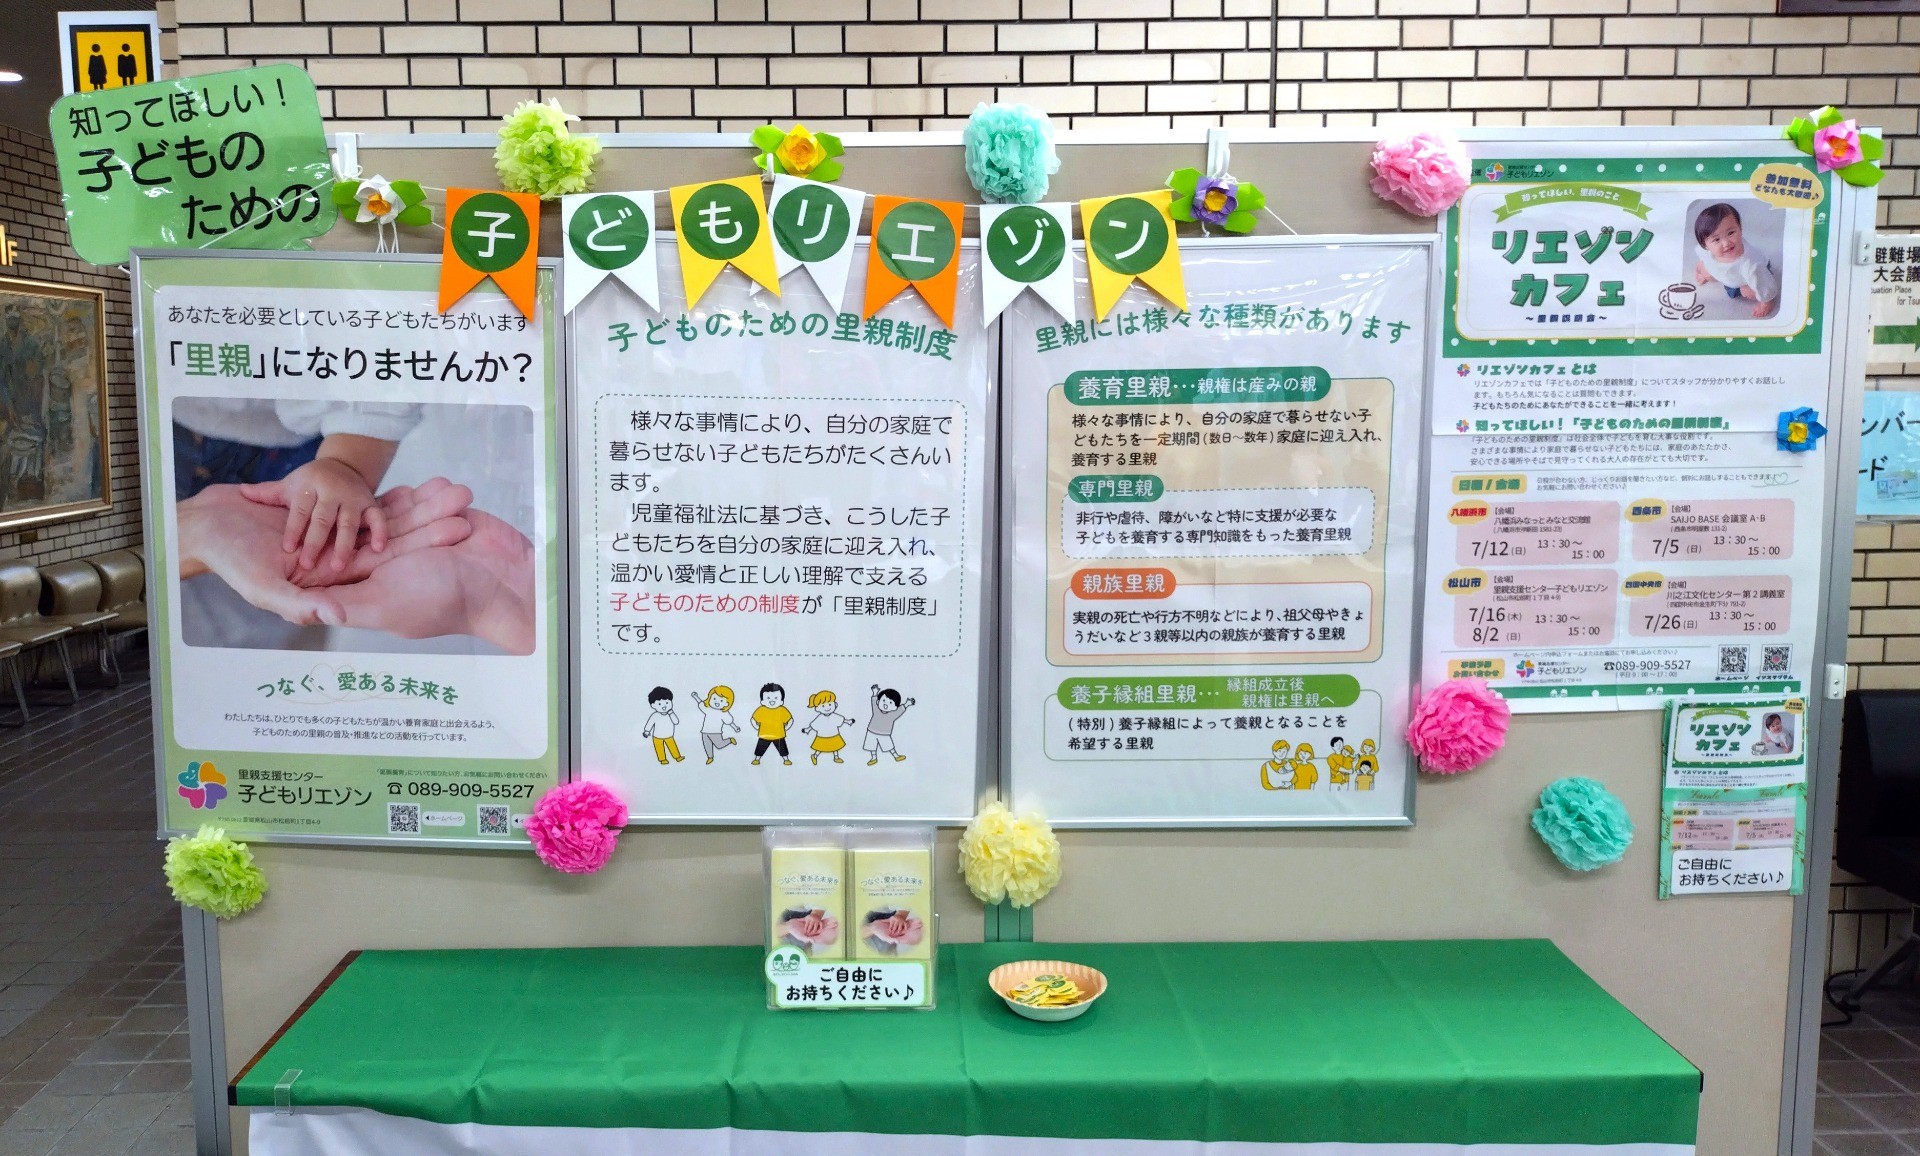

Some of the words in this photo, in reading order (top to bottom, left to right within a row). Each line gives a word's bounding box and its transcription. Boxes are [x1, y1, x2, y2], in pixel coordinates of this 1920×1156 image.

[69, 78, 287, 138] 知ってほしい！
[78, 130, 266, 194] 子どもの
[182, 183, 321, 241] ための
[1491, 225, 1655, 265] リエゾン
[1509, 272, 1626, 307] カフェ
[1894, 285, 1912, 294] Place
[1897, 296, 1906, 306] for
[168, 304, 527, 331] あなたを必要としている子どもたちがいます
[607, 310, 959, 362] 子どものための里親制度
[1035, 302, 1412, 354] 里親には様々な種類があります
[169, 340, 533, 383] 「里親」になりませんか？
[630, 410, 953, 436] 様々な事情により、自分の家庭で
[1071, 408, 1372, 428] 様々な事情により、自分の家庭で暮らせない子
[609, 441, 952, 466] 暮らせない子どもたちがたくさんい
[1071, 452, 1158, 467] 養育する里親
[609, 472, 661, 494] ます。
[1078, 479, 1153, 498] 専門里親
[631, 503, 951, 527] 児童福祉法に基づき、こうした子
[1076, 508, 1337, 526] 非行や虐待、障がいなど特に支援が必要な
[1671, 515, 1696, 524] SAIJO
[1698, 515, 1720, 523] BASE
[1722, 514, 1748, 523] 会議室
[611, 534, 937, 557] どもたちを自分の家庭に迎え入れ、
[1076, 527, 1352, 545] 子どもを養育する専門知識をもった養育里親
[1472, 541, 1509, 559] 7/12
[1511, 546, 1526, 555] (日)
[1652, 538, 1680, 558] 7/5
[1686, 545, 1702, 555] (日)
[610, 563, 928, 588] 温かい愛情と正しい理解で支える
[1082, 574, 1165, 594] 親族里親
[1448, 577, 1481, 588] 松山市
[609, 593, 938, 618] 子どものための制度が「里親制度」
[1072, 607, 1364, 625] 実親の死亡や行方不明などにより、祖父母やきょ
[1469, 607, 1506, 625] 7/16
[1507, 612, 1522, 622] (木)
[1645, 614, 1681, 633] 7/26
[1683, 621, 1698, 630] (日)
[611, 623, 663, 645] です。
[1073, 626, 1346, 643] うだいなど3親等以内の親族が養育する里親
[1472, 627, 1499, 644] 8/2
[1507, 633, 1521, 642] (日)
[1537, 667, 1587, 675] 子どもリエゾン
[1615, 660, 1692, 671] 089-909-5527
[257, 671, 459, 705] つなぐ、愛ある未来を
[1226, 677, 1305, 693] 縁組成立後
[1241, 692, 1335, 708] 親権は里親へ
[1690, 722, 1752, 737] リエゾン
[1068, 736, 1154, 751] 希望する里親
[1695, 738, 1740, 752] カフェ
[238, 768, 323, 782] 里親支援センター
[238, 784, 372, 806] 子どもリエゾン
[408, 781, 535, 798] 089-909-5527
[1678, 858, 1732, 871] ご自由に
[820, 966, 882, 983] ご自由に
